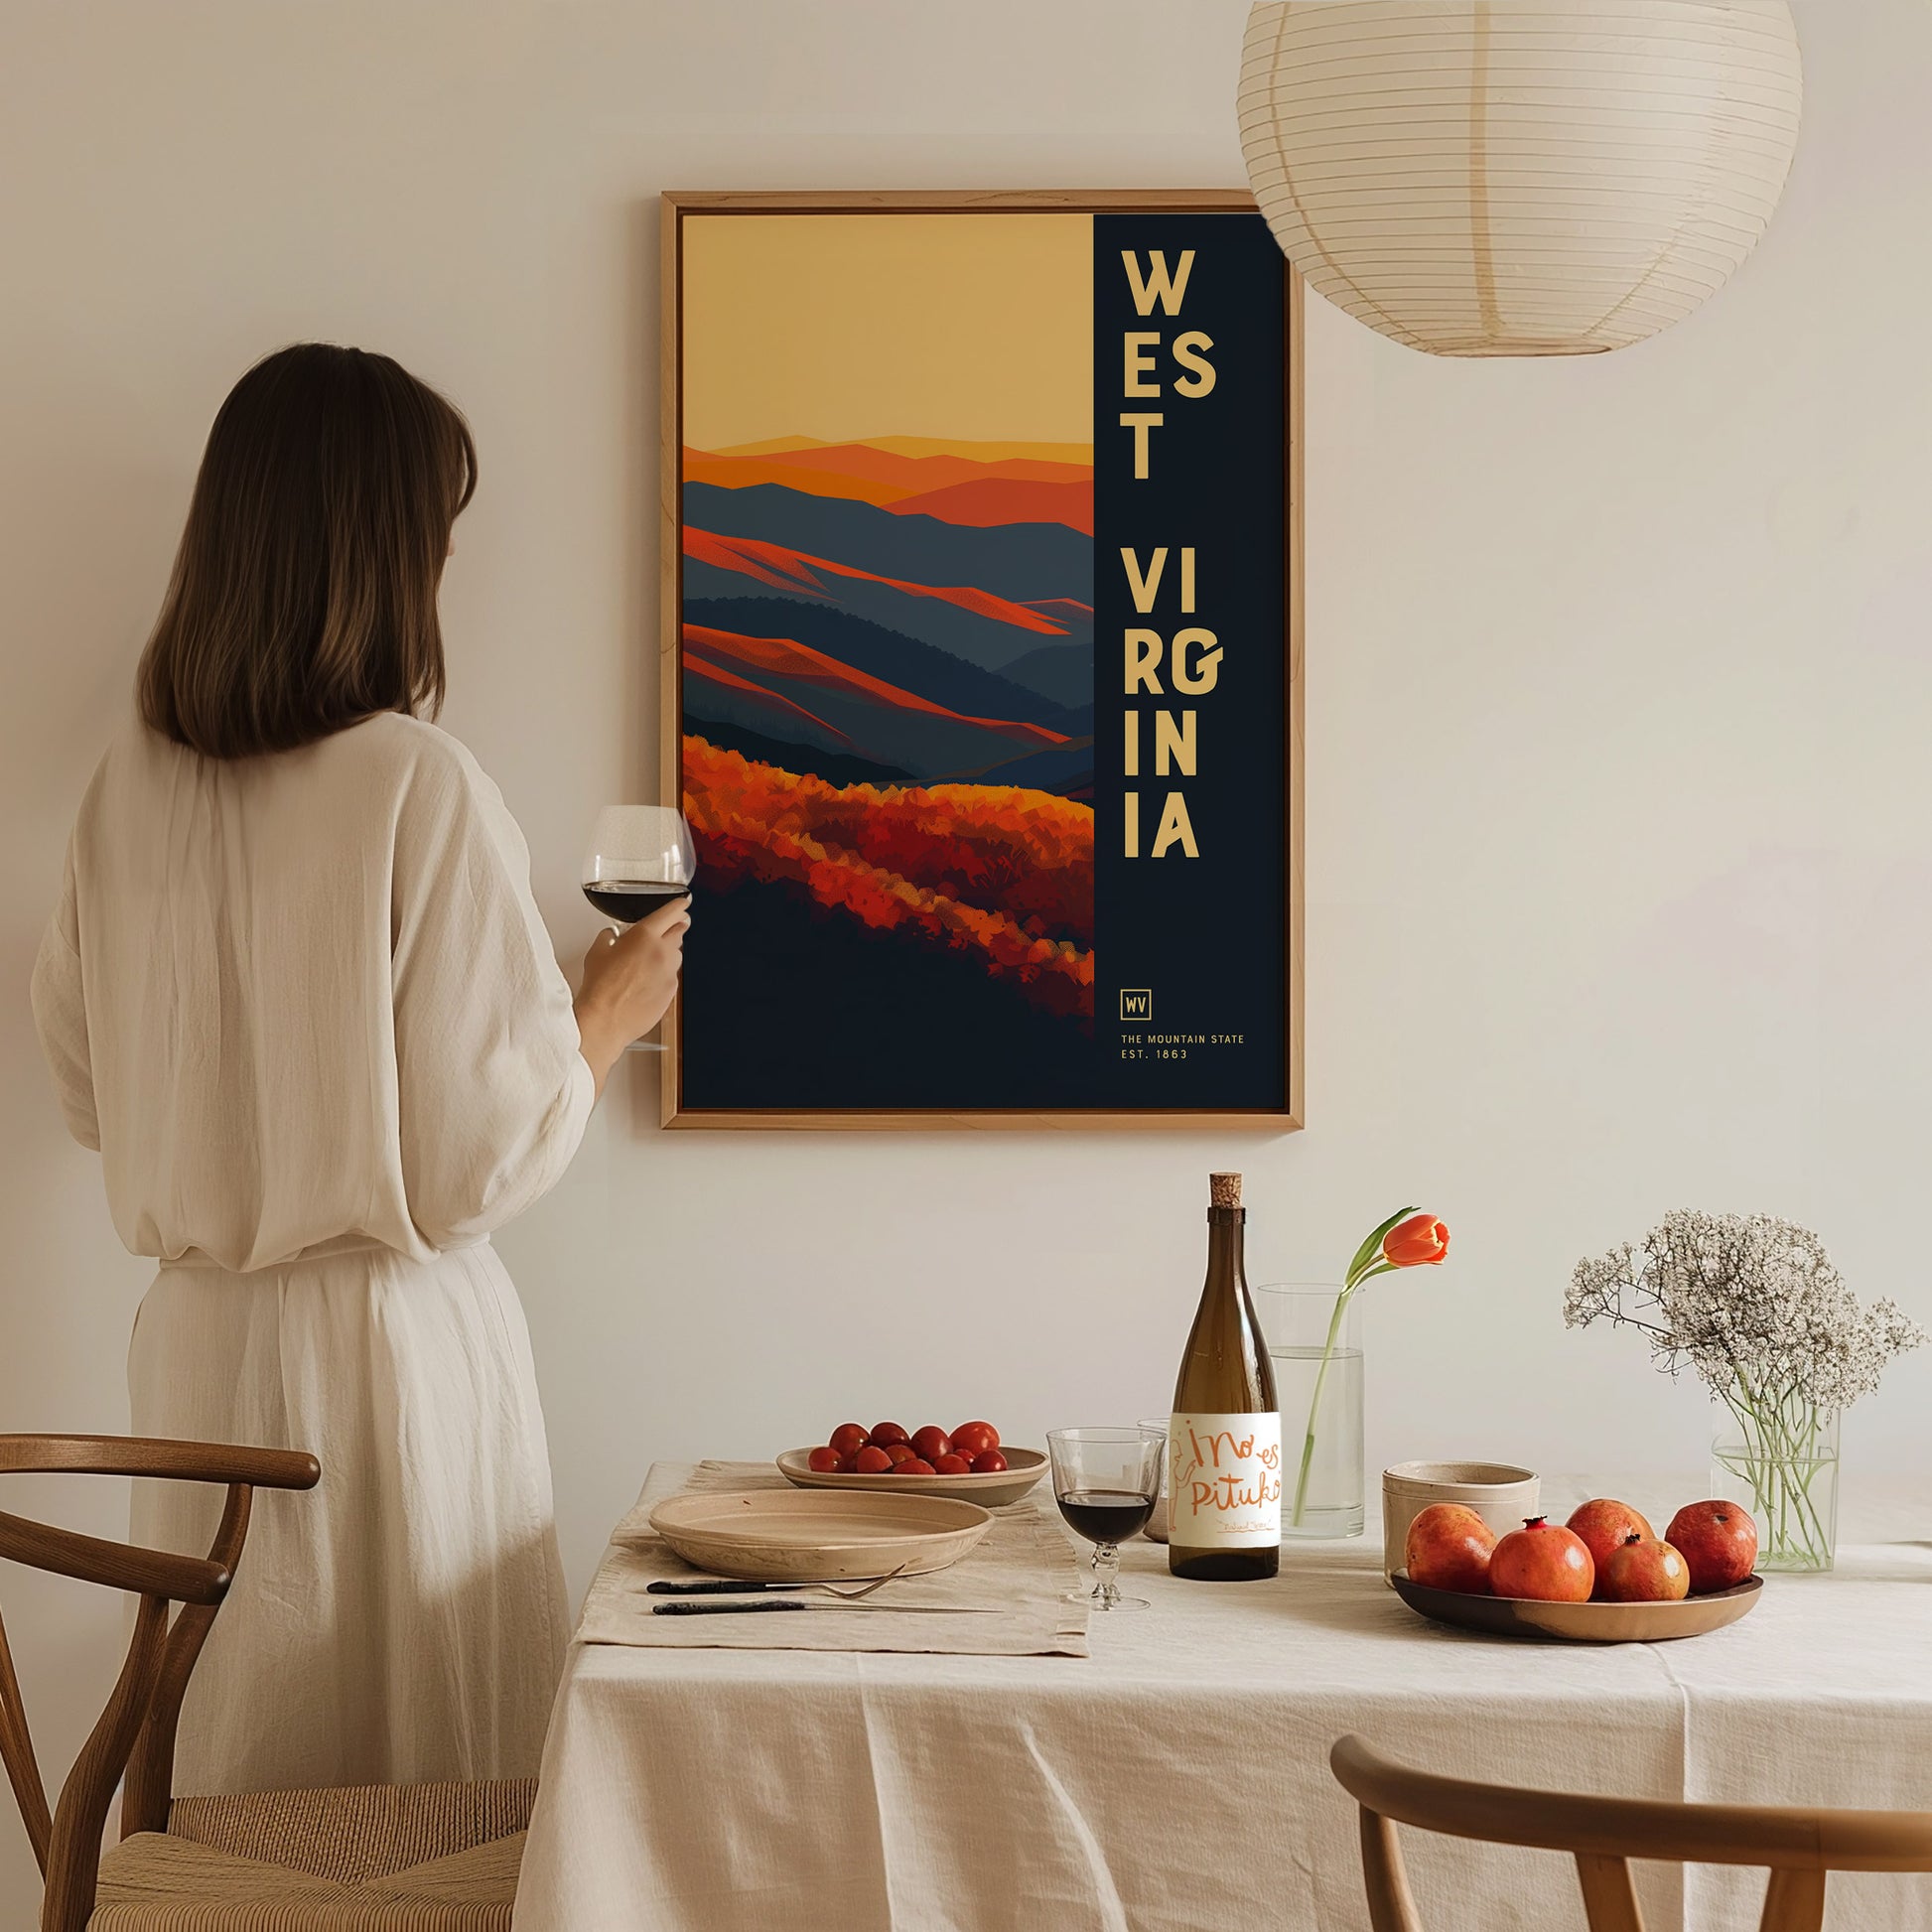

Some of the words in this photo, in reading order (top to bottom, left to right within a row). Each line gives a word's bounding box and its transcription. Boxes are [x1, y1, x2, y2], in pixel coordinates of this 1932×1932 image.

[1125, 996, 1147, 1013] WV
[1121, 1035, 1142, 1043] THE
[1148, 1035, 1205, 1044] MOUNTAIN
[1210, 1035, 1244, 1043] STATE
[1121, 1049, 1149, 1059] EST.
[1156, 1049, 1187, 1059] 1863
[1256, 1444, 1279, 1469] es
